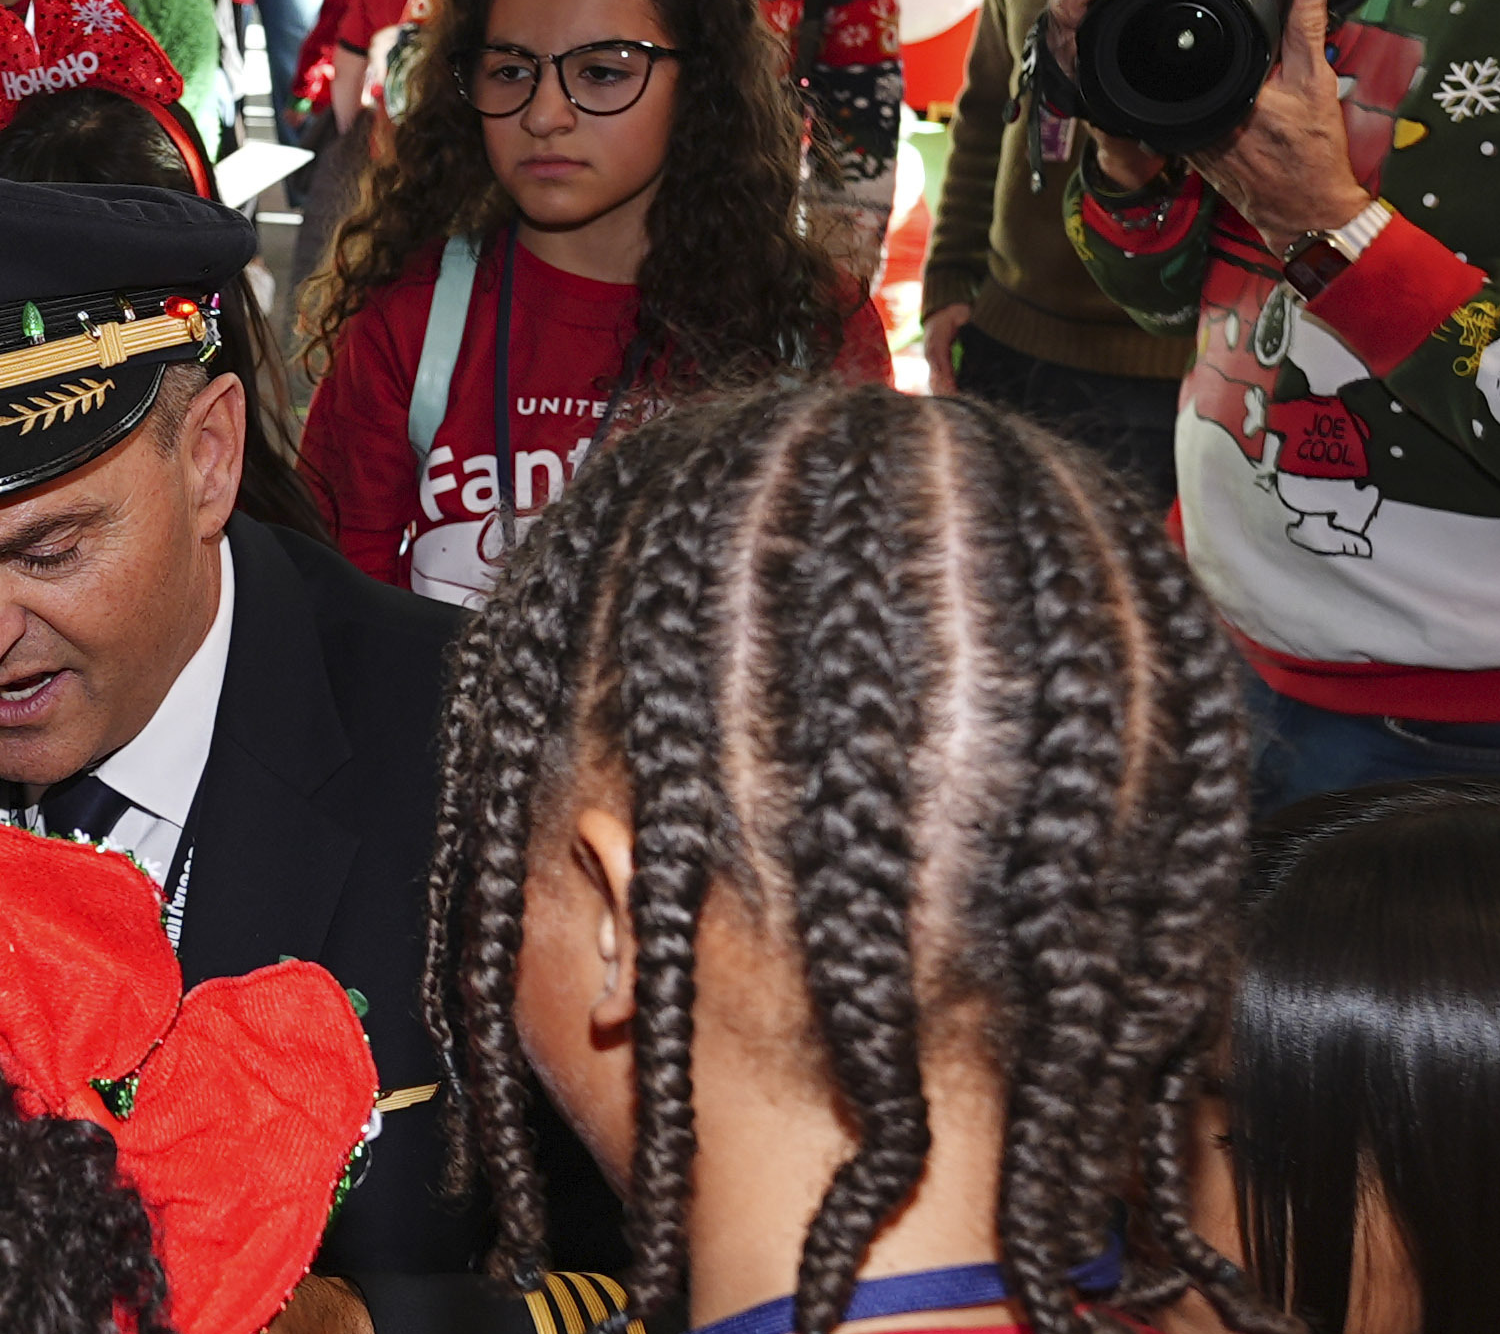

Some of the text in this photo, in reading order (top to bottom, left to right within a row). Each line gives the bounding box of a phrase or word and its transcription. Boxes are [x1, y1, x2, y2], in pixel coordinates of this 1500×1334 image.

[516, 396, 634, 419] UNITE
[1303, 413, 1346, 440] JOE
[1297, 439, 1355, 466] COOL
